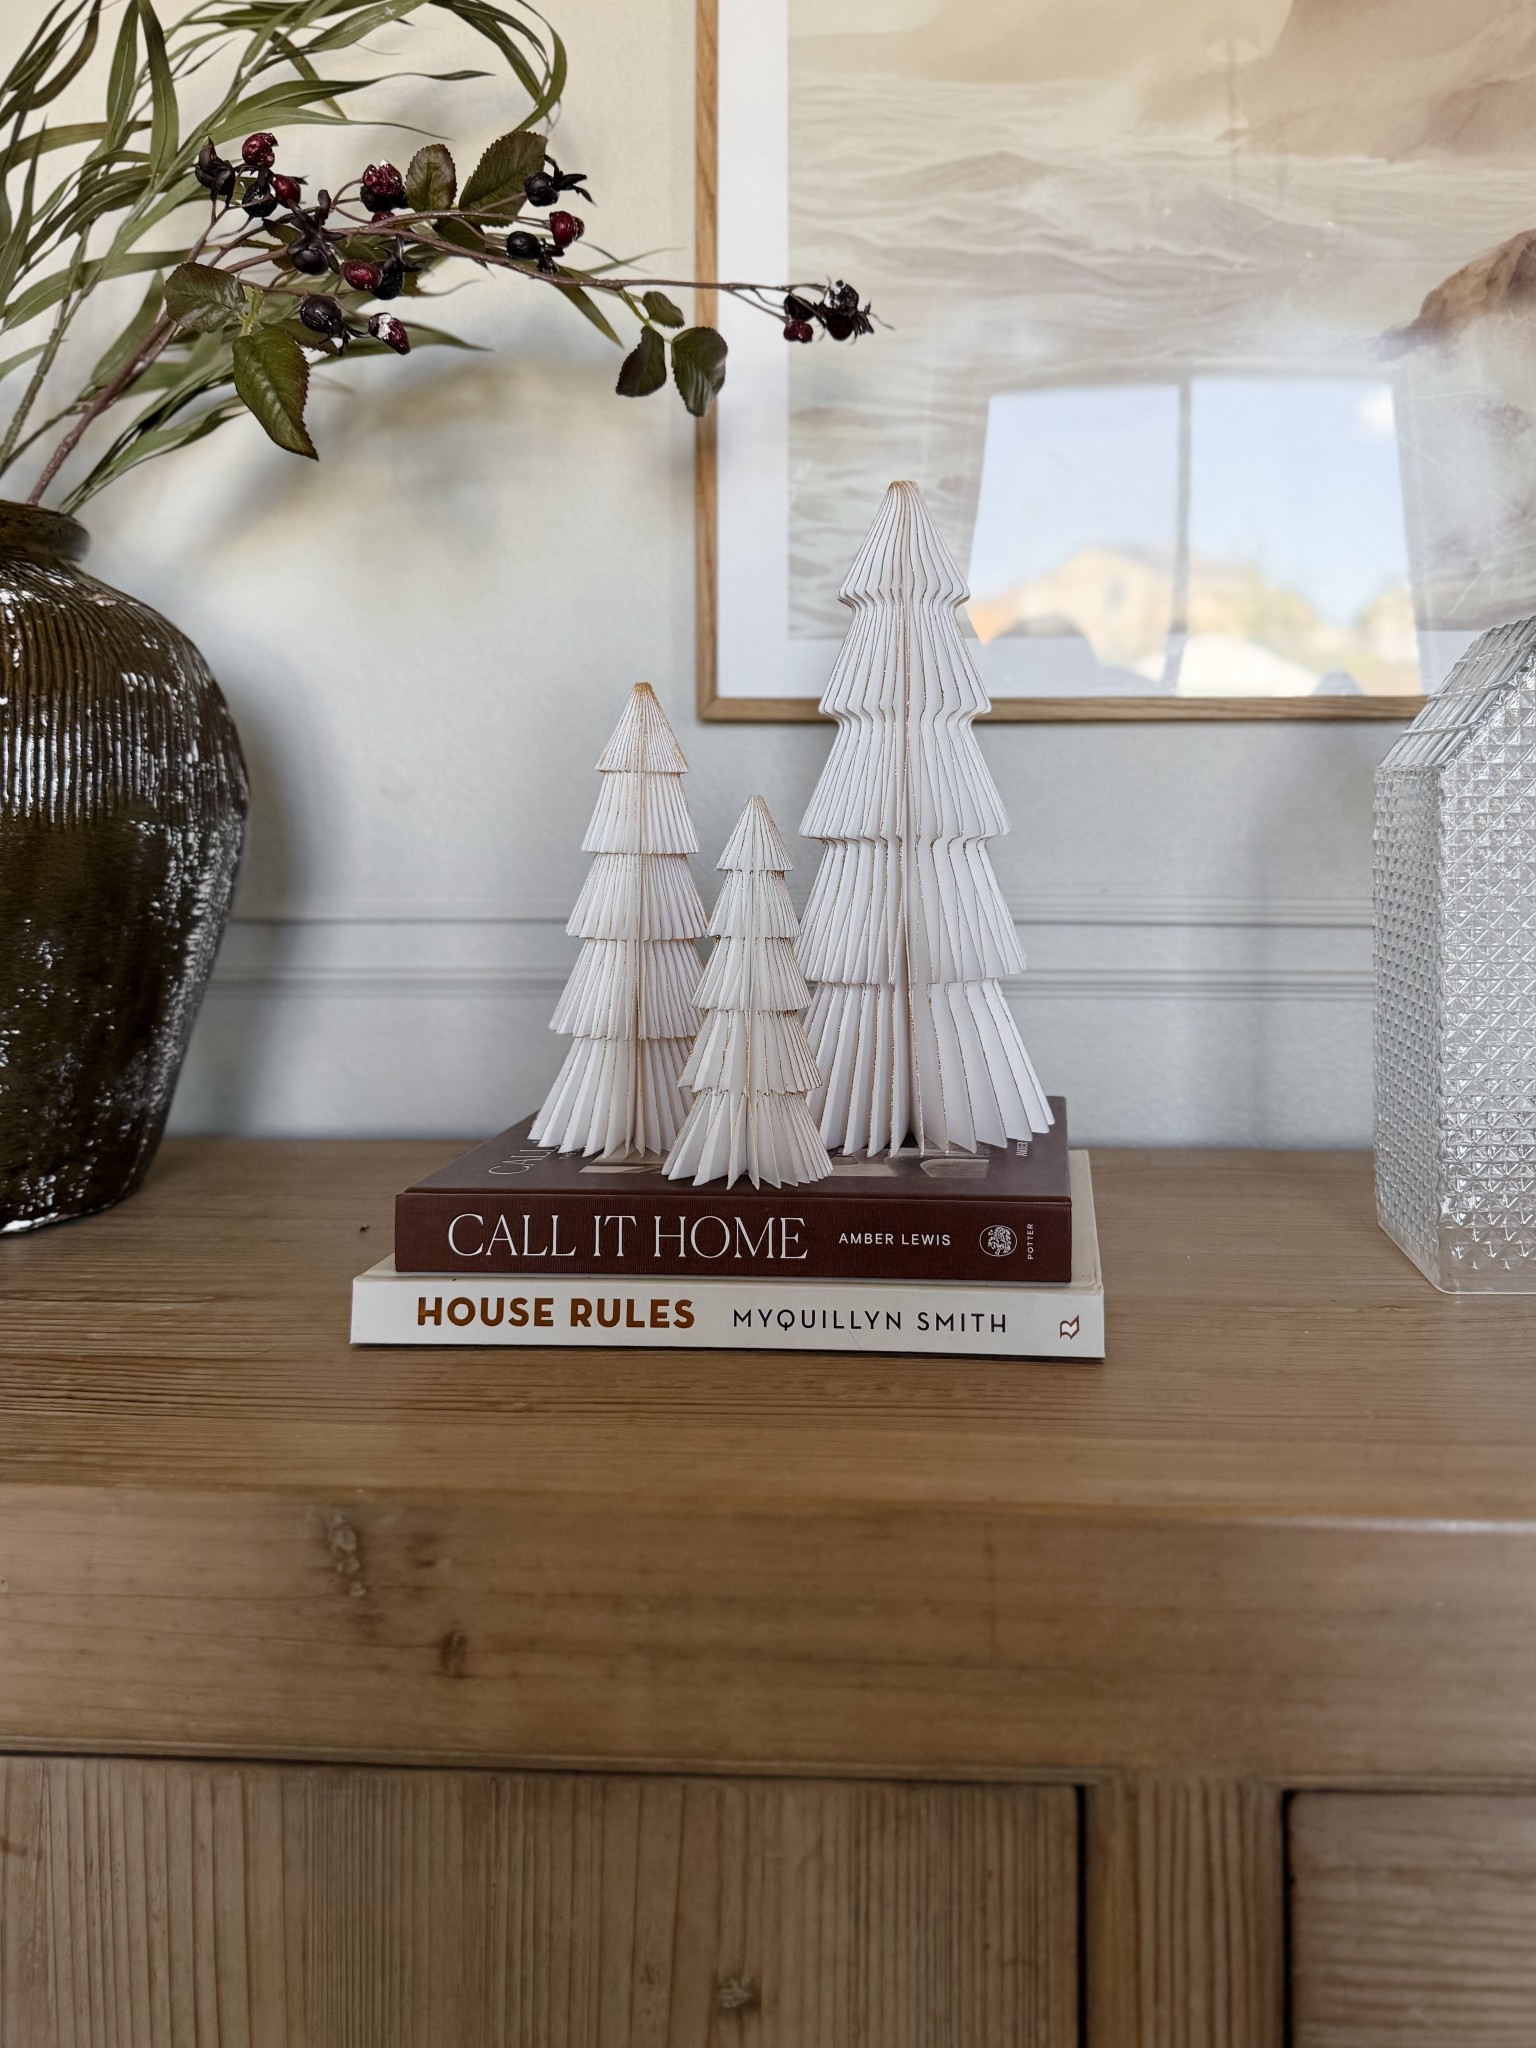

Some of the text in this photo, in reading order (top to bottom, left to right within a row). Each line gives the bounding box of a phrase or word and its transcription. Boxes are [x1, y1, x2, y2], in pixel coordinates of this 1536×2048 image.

[488, 1145, 559, 1175] CALL
[447, 1213, 808, 1260] CALL IT HOME
[839, 1232, 951, 1246] AMBER LEWIS
[1026, 1223, 1034, 1260] POTTER
[417, 1296, 696, 1329] HOUSE RULES
[732, 1308, 1007, 1333] MYQUILLYN SMITH
